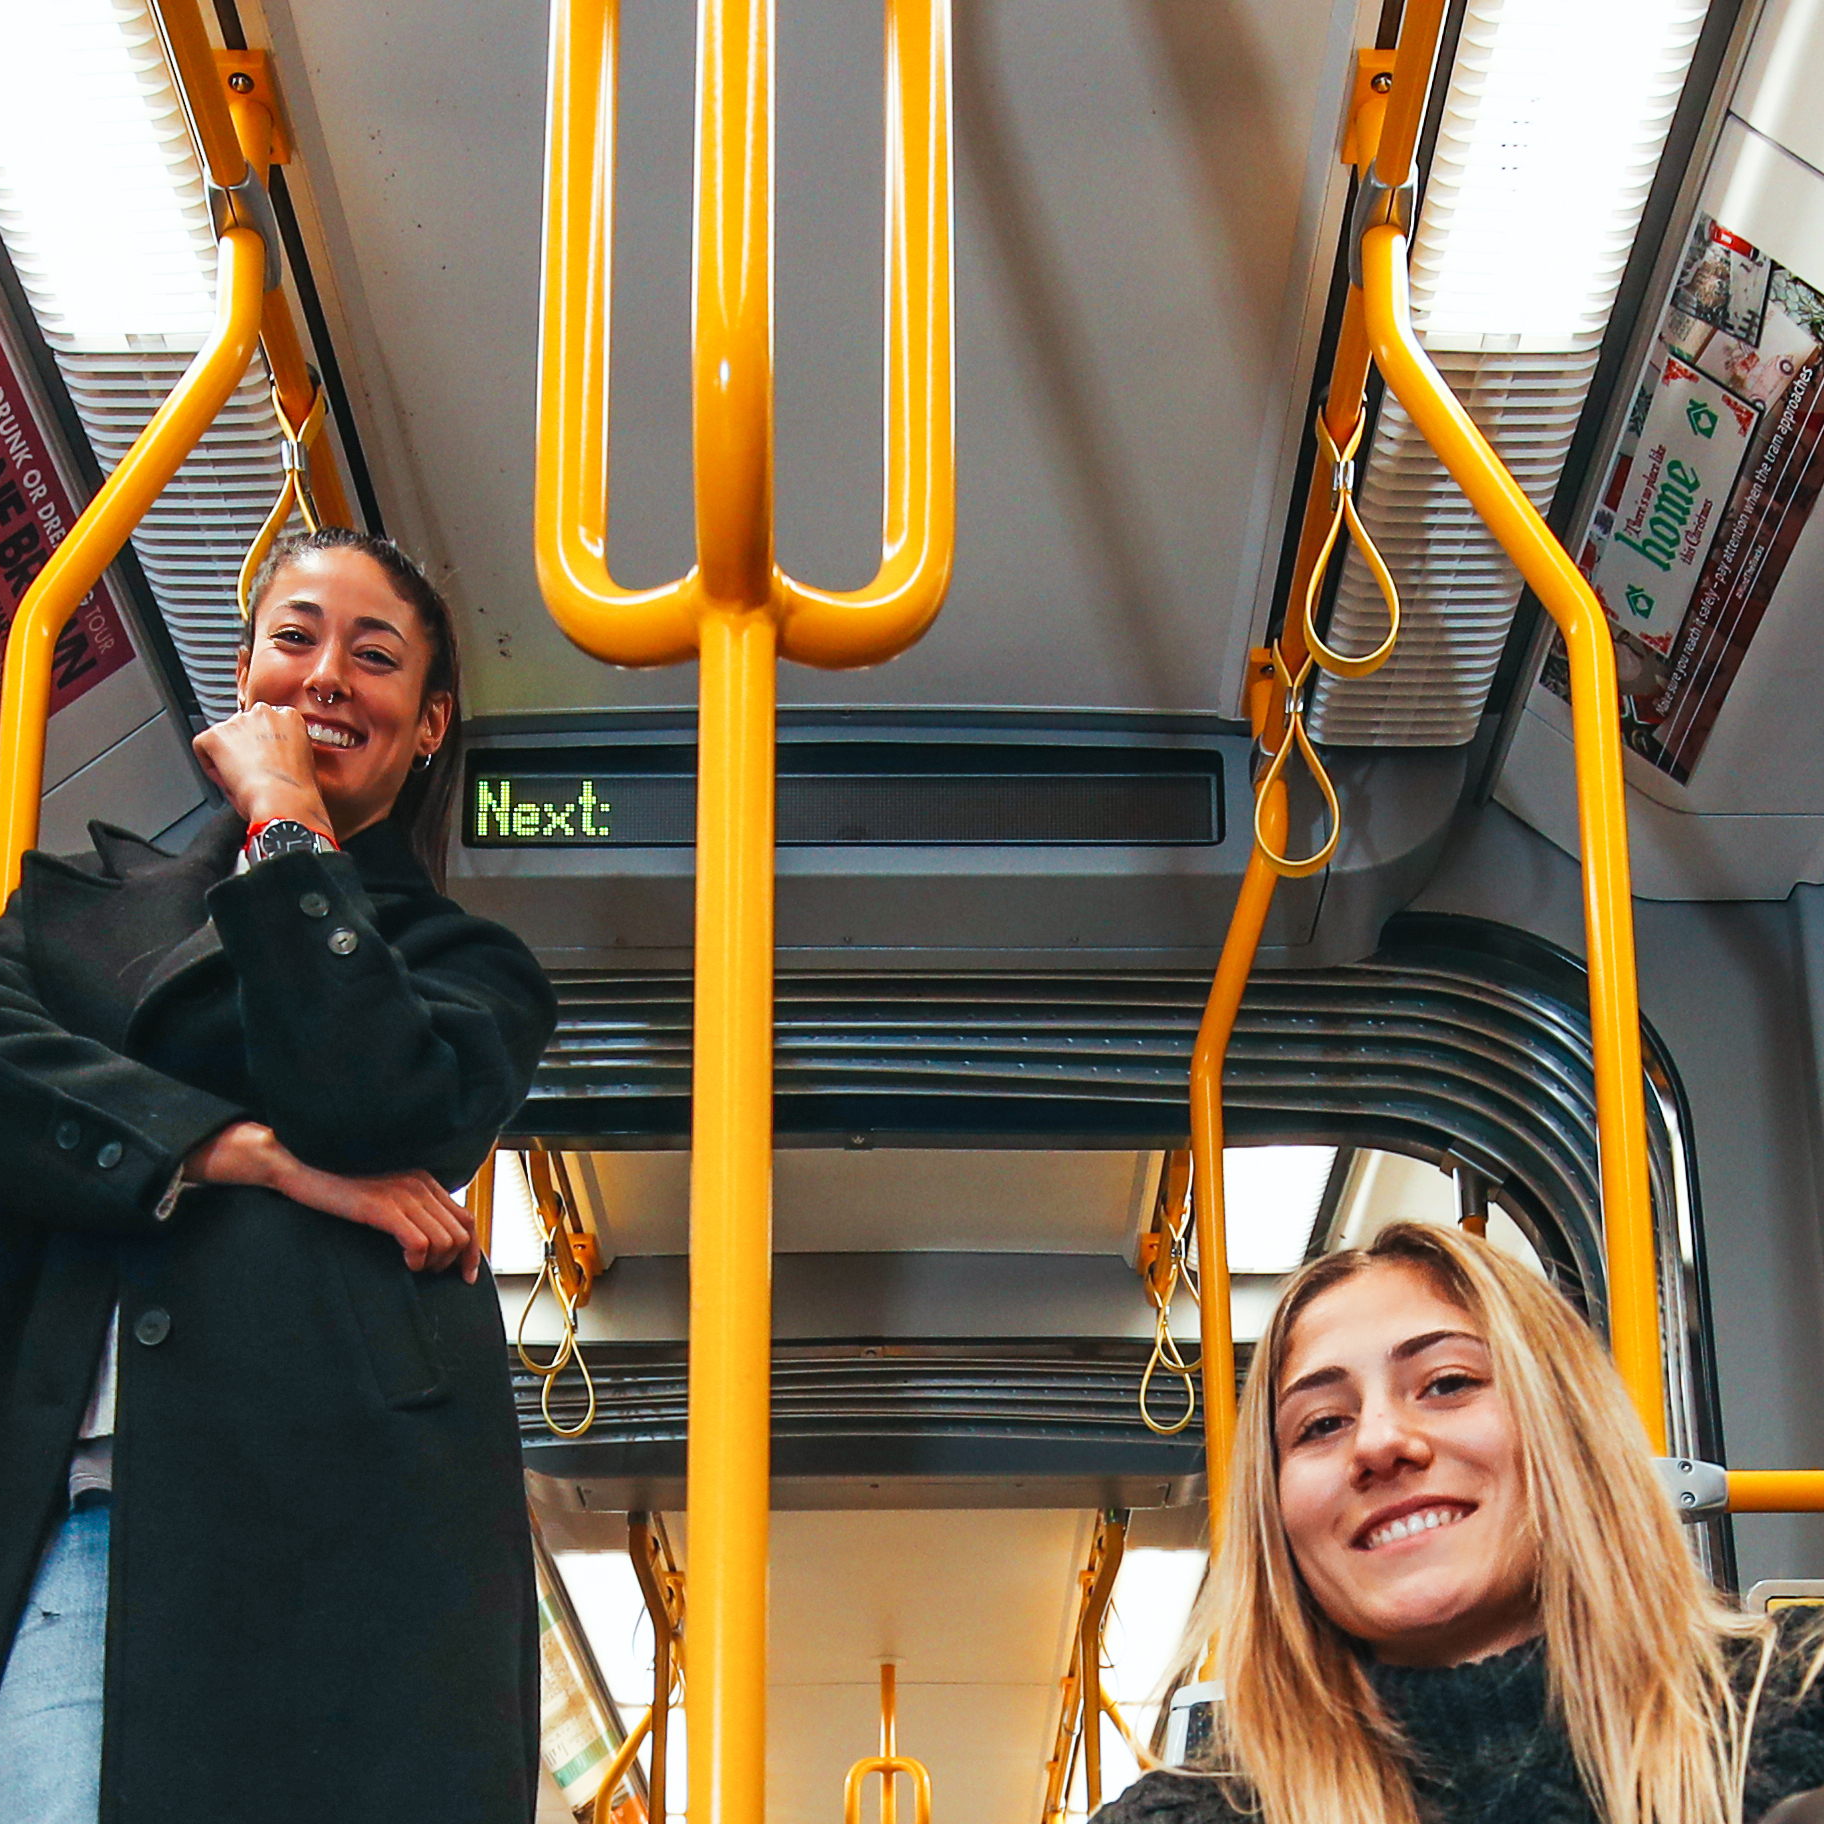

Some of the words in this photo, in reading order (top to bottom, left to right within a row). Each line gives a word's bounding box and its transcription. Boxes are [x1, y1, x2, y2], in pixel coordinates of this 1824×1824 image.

[1774, 362, 1817, 438] approaches
[1648, 438, 1668, 465] like
[1762, 431, 1784, 464] tram
[1642, 459, 1664, 491] place
[1753, 459, 1772, 484] the
[1612, 436, 1704, 575] home
[1640, 484, 1653, 501] no
[1740, 480, 1763, 515] when
[1622, 492, 1651, 540] There's
[1681, 491, 1714, 549] Christmas
[1719, 510, 1750, 563] attention
[19, 464, 50, 505] OR
[82, 604, 116, 655] TOUR
[1677, 541, 1696, 566] this
[1713, 560, 1733, 584] pay
[1695, 585, 1721, 622] safely
[1680, 624, 1702, 656] reach
[1674, 652, 1693, 677] you
[1666, 671, 1682, 694] sure
[1654, 688, 1674, 717] Make
[478, 781, 610, 836] Next:
